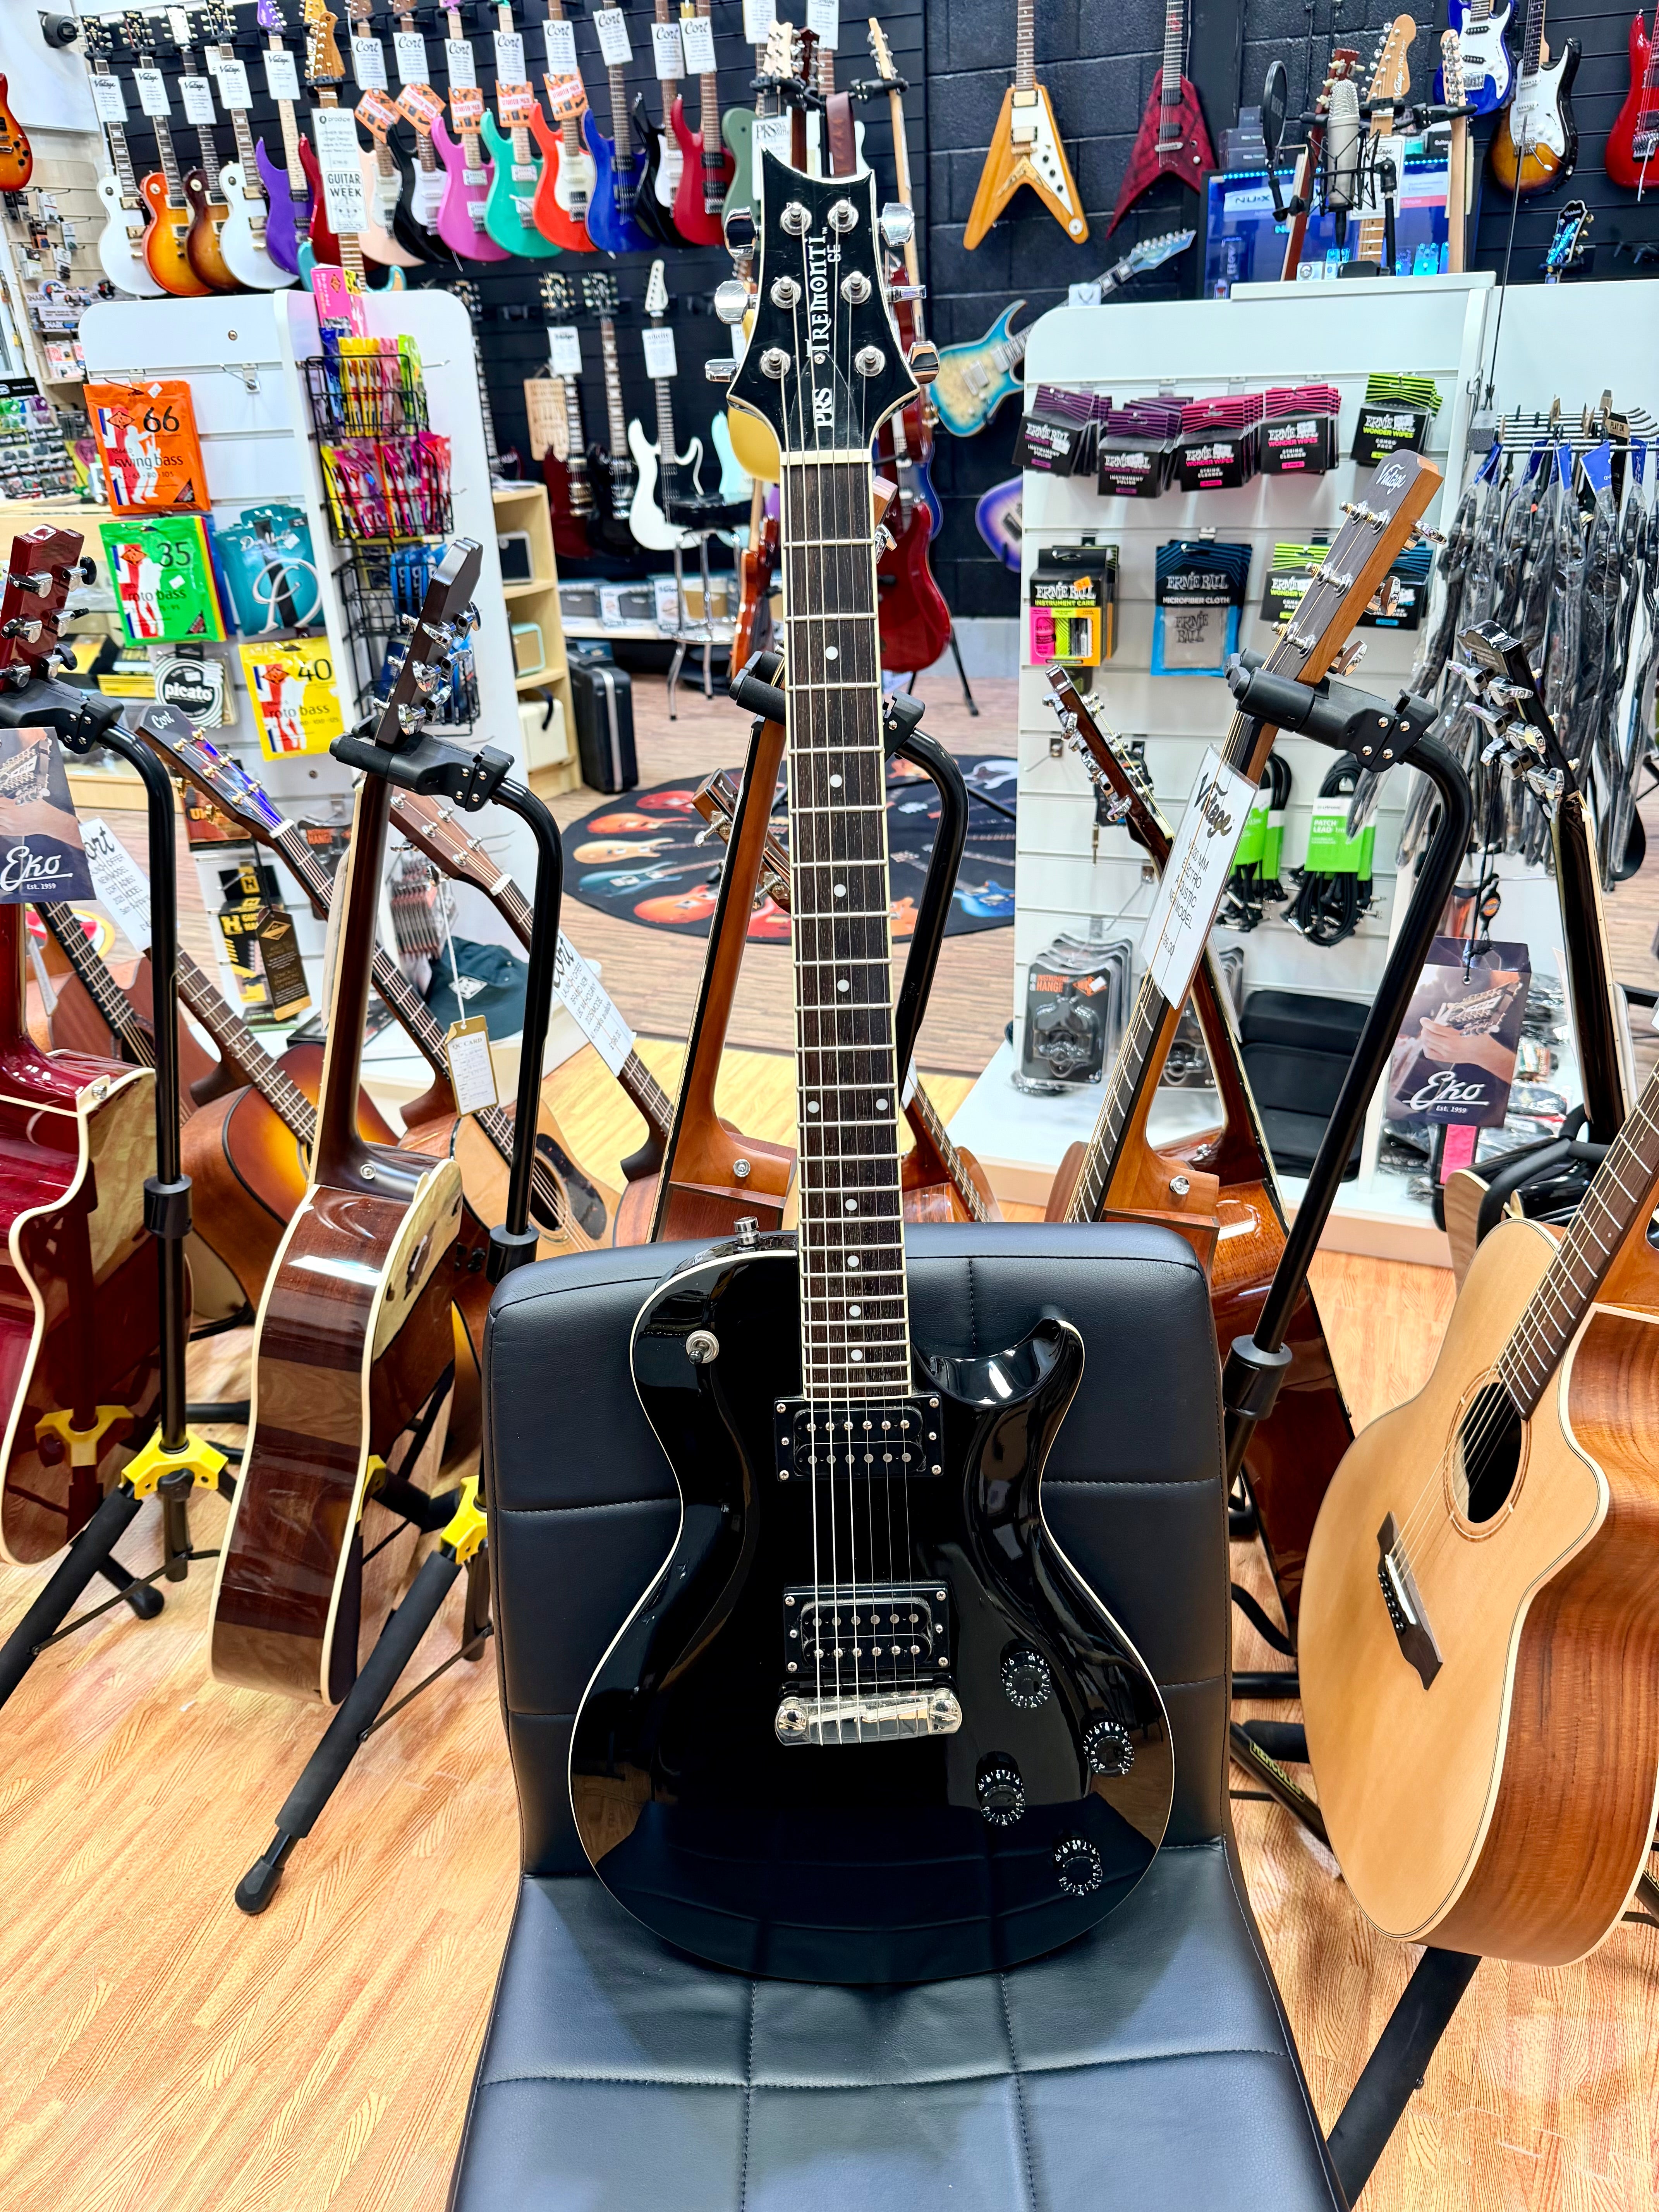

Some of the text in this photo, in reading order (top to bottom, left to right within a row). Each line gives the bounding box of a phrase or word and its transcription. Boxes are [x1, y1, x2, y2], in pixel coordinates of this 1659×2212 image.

[547, 24, 569, 36] Cort
[685, 22, 708, 34] Cort
[356, 40, 378, 52] Cort
[398, 36, 421, 48] Cort
[449, 42, 469, 55] Cort
[498, 35, 519, 48] Cort
[328, 174, 361, 184] GUITAR
[330, 188, 361, 197] WEEK
[814, 387, 833, 428] PRS
[143, 406, 179, 433] 66
[1364, 414, 1394, 429] ERNIE
[1025, 423, 1051, 440] ERNIE
[1268, 424, 1297, 441] ERNIE
[1363, 426, 1392, 436] WONDER
[1268, 439, 1297, 447] WONDER
[1185, 445, 1212, 461] ERNIE
[115, 453, 183, 470] swing bass
[1375, 464, 1406, 495] Vintage
[156, 541, 190, 567] 35
[1166, 571, 1229, 590] ERNIE BALL
[128, 589, 187, 601] roto bass
[1035, 581, 1069, 599] ERNIE
[1163, 596, 1204, 604] MICROFIBER
[1175, 611, 1209, 629] ERNIE
[1177, 630, 1204, 643] BALL
[298, 658, 332, 682] 40
[165, 682, 213, 701] picato
[270, 704, 330, 718] roto bass
[151, 710, 175, 729] Cort
[84, 826, 115, 860] ort
[0, 845, 62, 891] Eko
[1175, 900, 1192, 929] MODEL
[464, 1037, 483, 1046] CARD
[1410, 1071, 1486, 1110] Eko
